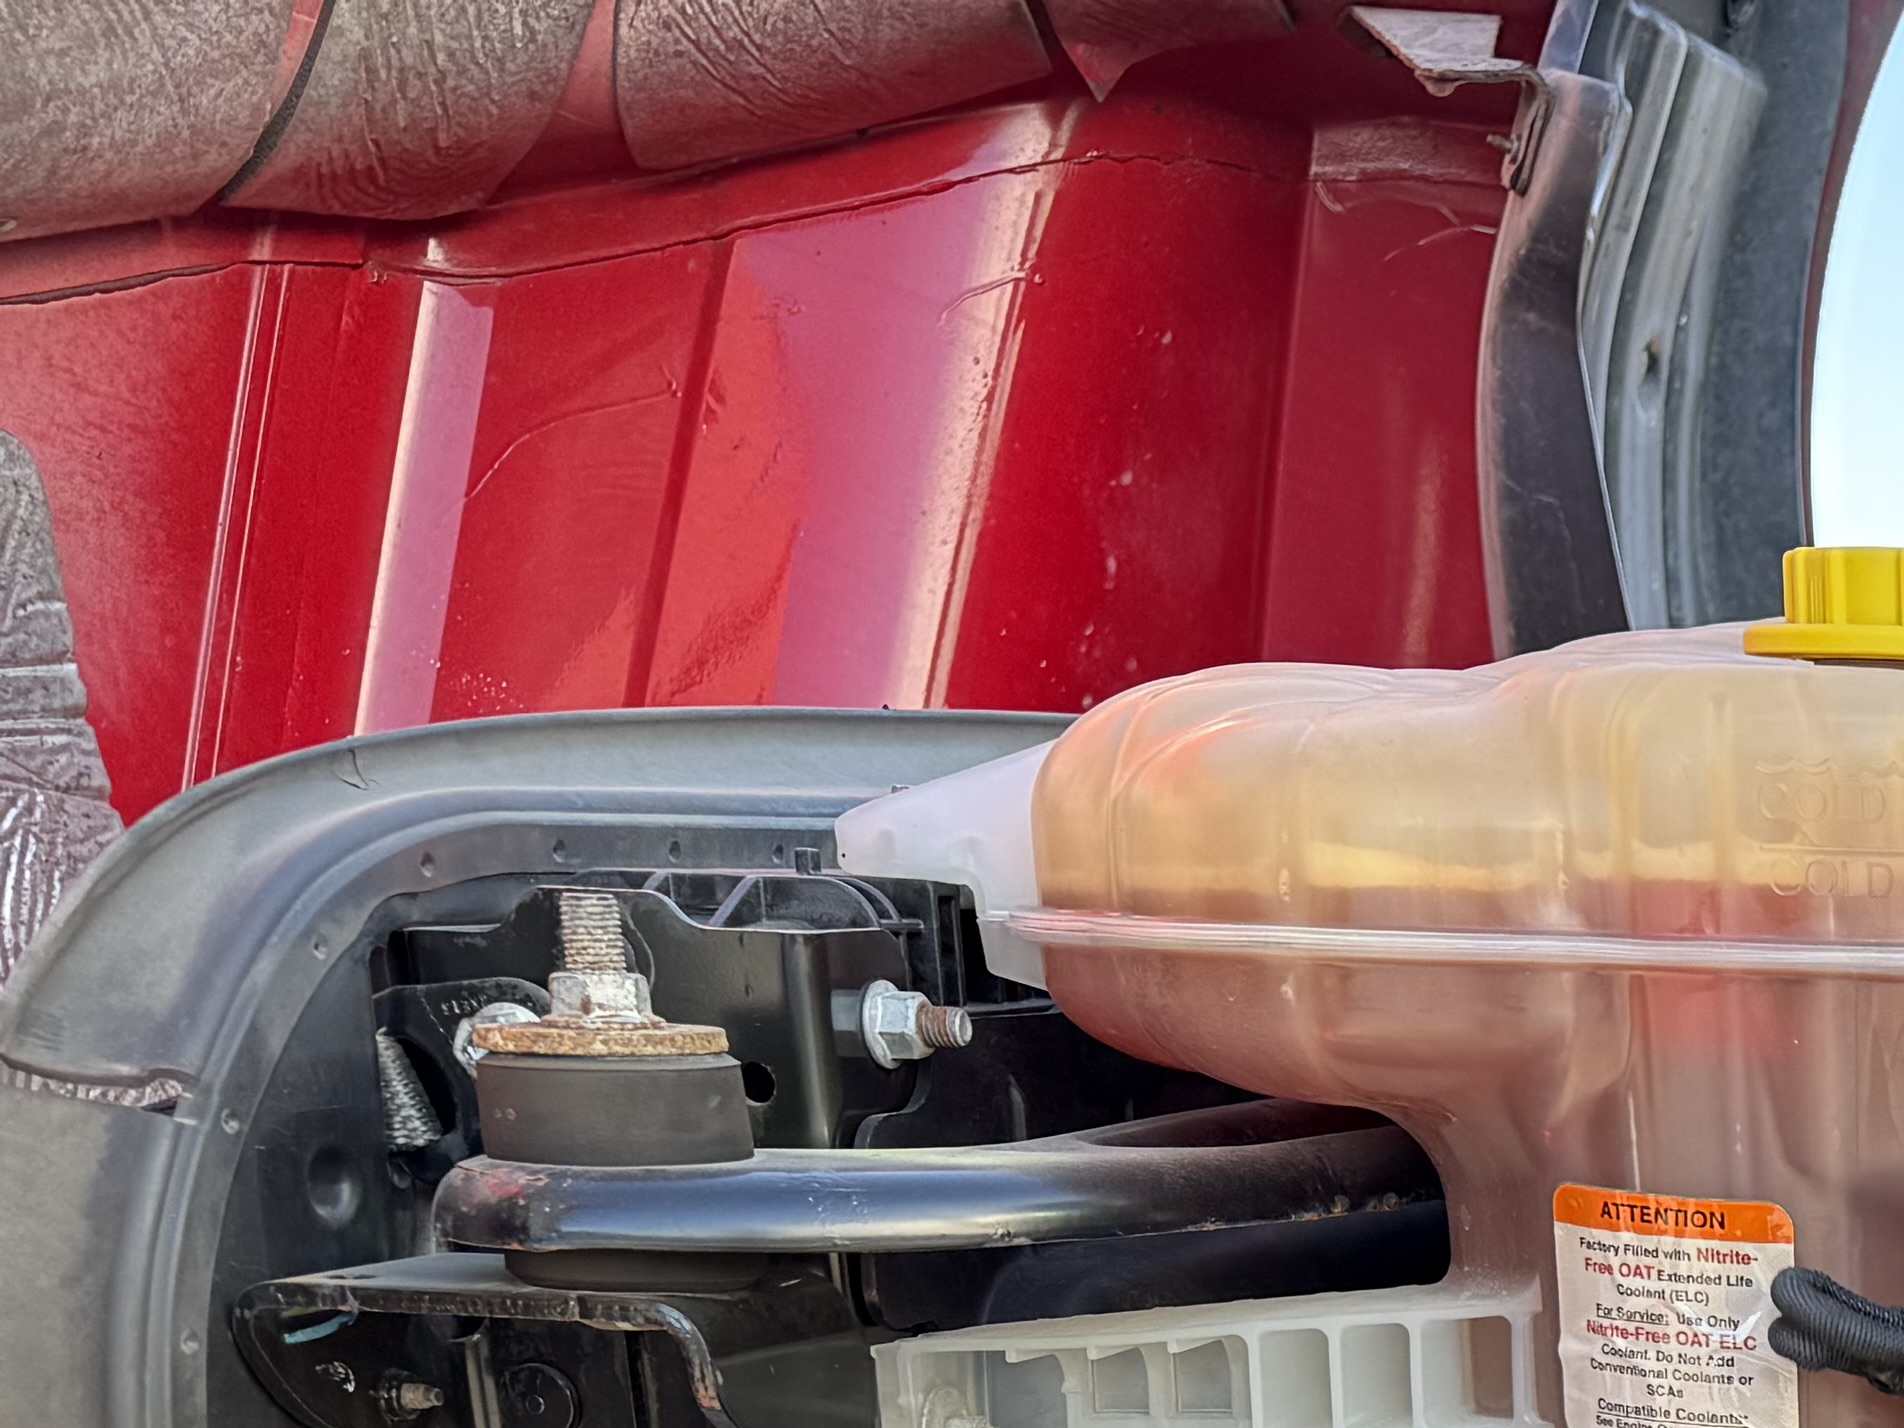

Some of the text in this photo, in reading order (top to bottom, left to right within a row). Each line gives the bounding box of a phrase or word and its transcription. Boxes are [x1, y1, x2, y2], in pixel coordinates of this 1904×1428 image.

[1600, 1200, 1726, 1230] ATTENTION
[1579, 1236, 1758, 1266] Factory Filled with Nitrite-
[1584, 1258, 1753, 1288] Free OAT Extended Life
[1616, 1284, 1710, 1307] Coolant (ELC)
[1596, 1303, 1614, 1318] For
[1677, 1313, 1703, 1327] Use
[1707, 1316, 1740, 1332] Only
[1586, 1320, 1758, 1351] Nitrite-Free OAT ELC
[1601, 1344, 1735, 1368] Coolant. Do Not Add
[1590, 1358, 1754, 1386] Conventional Coolants or
[1596, 1415, 1614, 1428] See
[1597, 1398, 1671, 1421] Compatible
